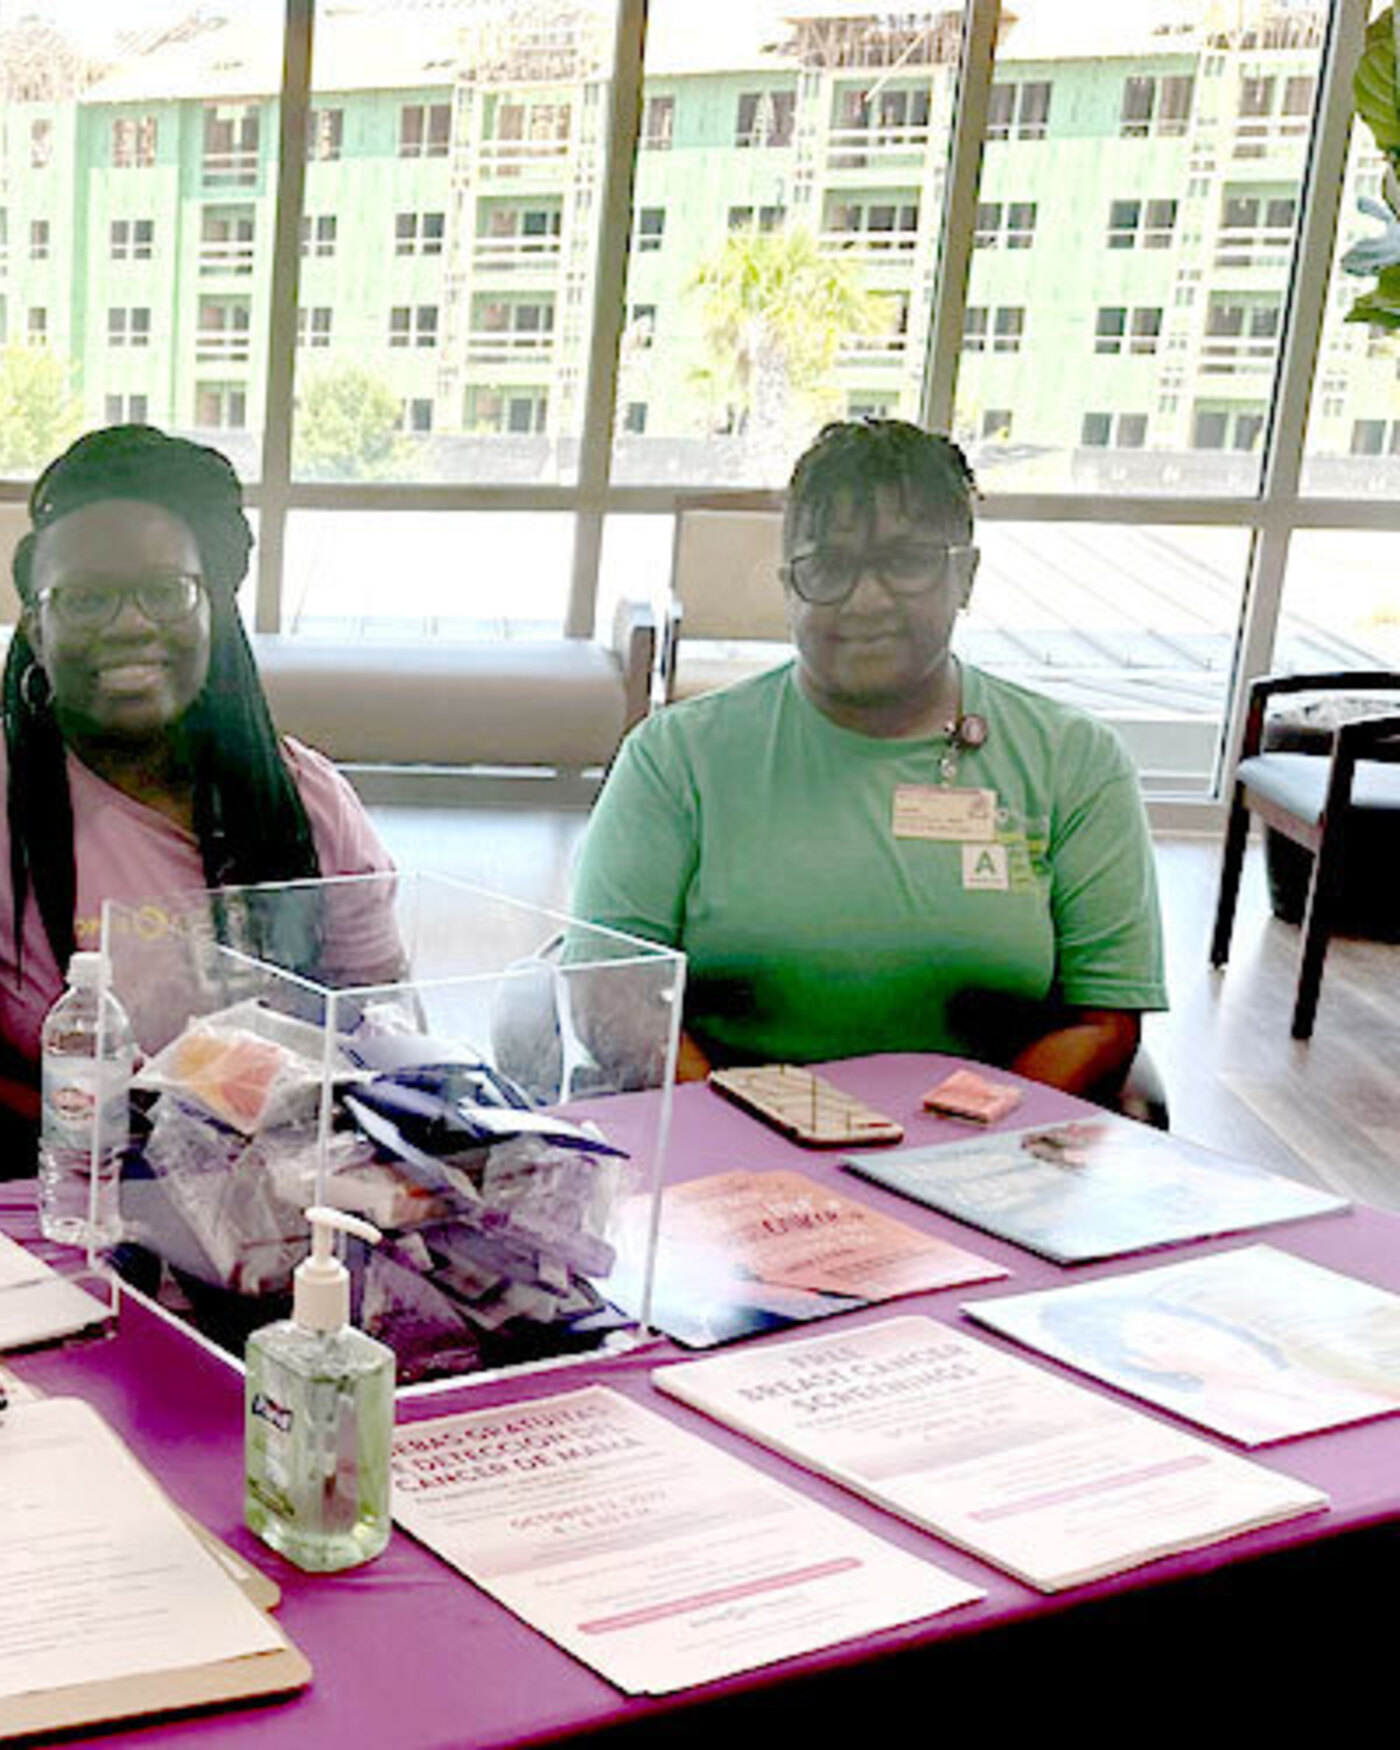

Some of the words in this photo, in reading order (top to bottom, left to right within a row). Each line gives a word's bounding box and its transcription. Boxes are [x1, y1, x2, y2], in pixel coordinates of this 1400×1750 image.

[975, 851, 996, 875] A
[737, 1369, 849, 1402] BREAST
[850, 1344, 970, 1377] CANCER
[790, 1365, 977, 1413] SCREENINGS
